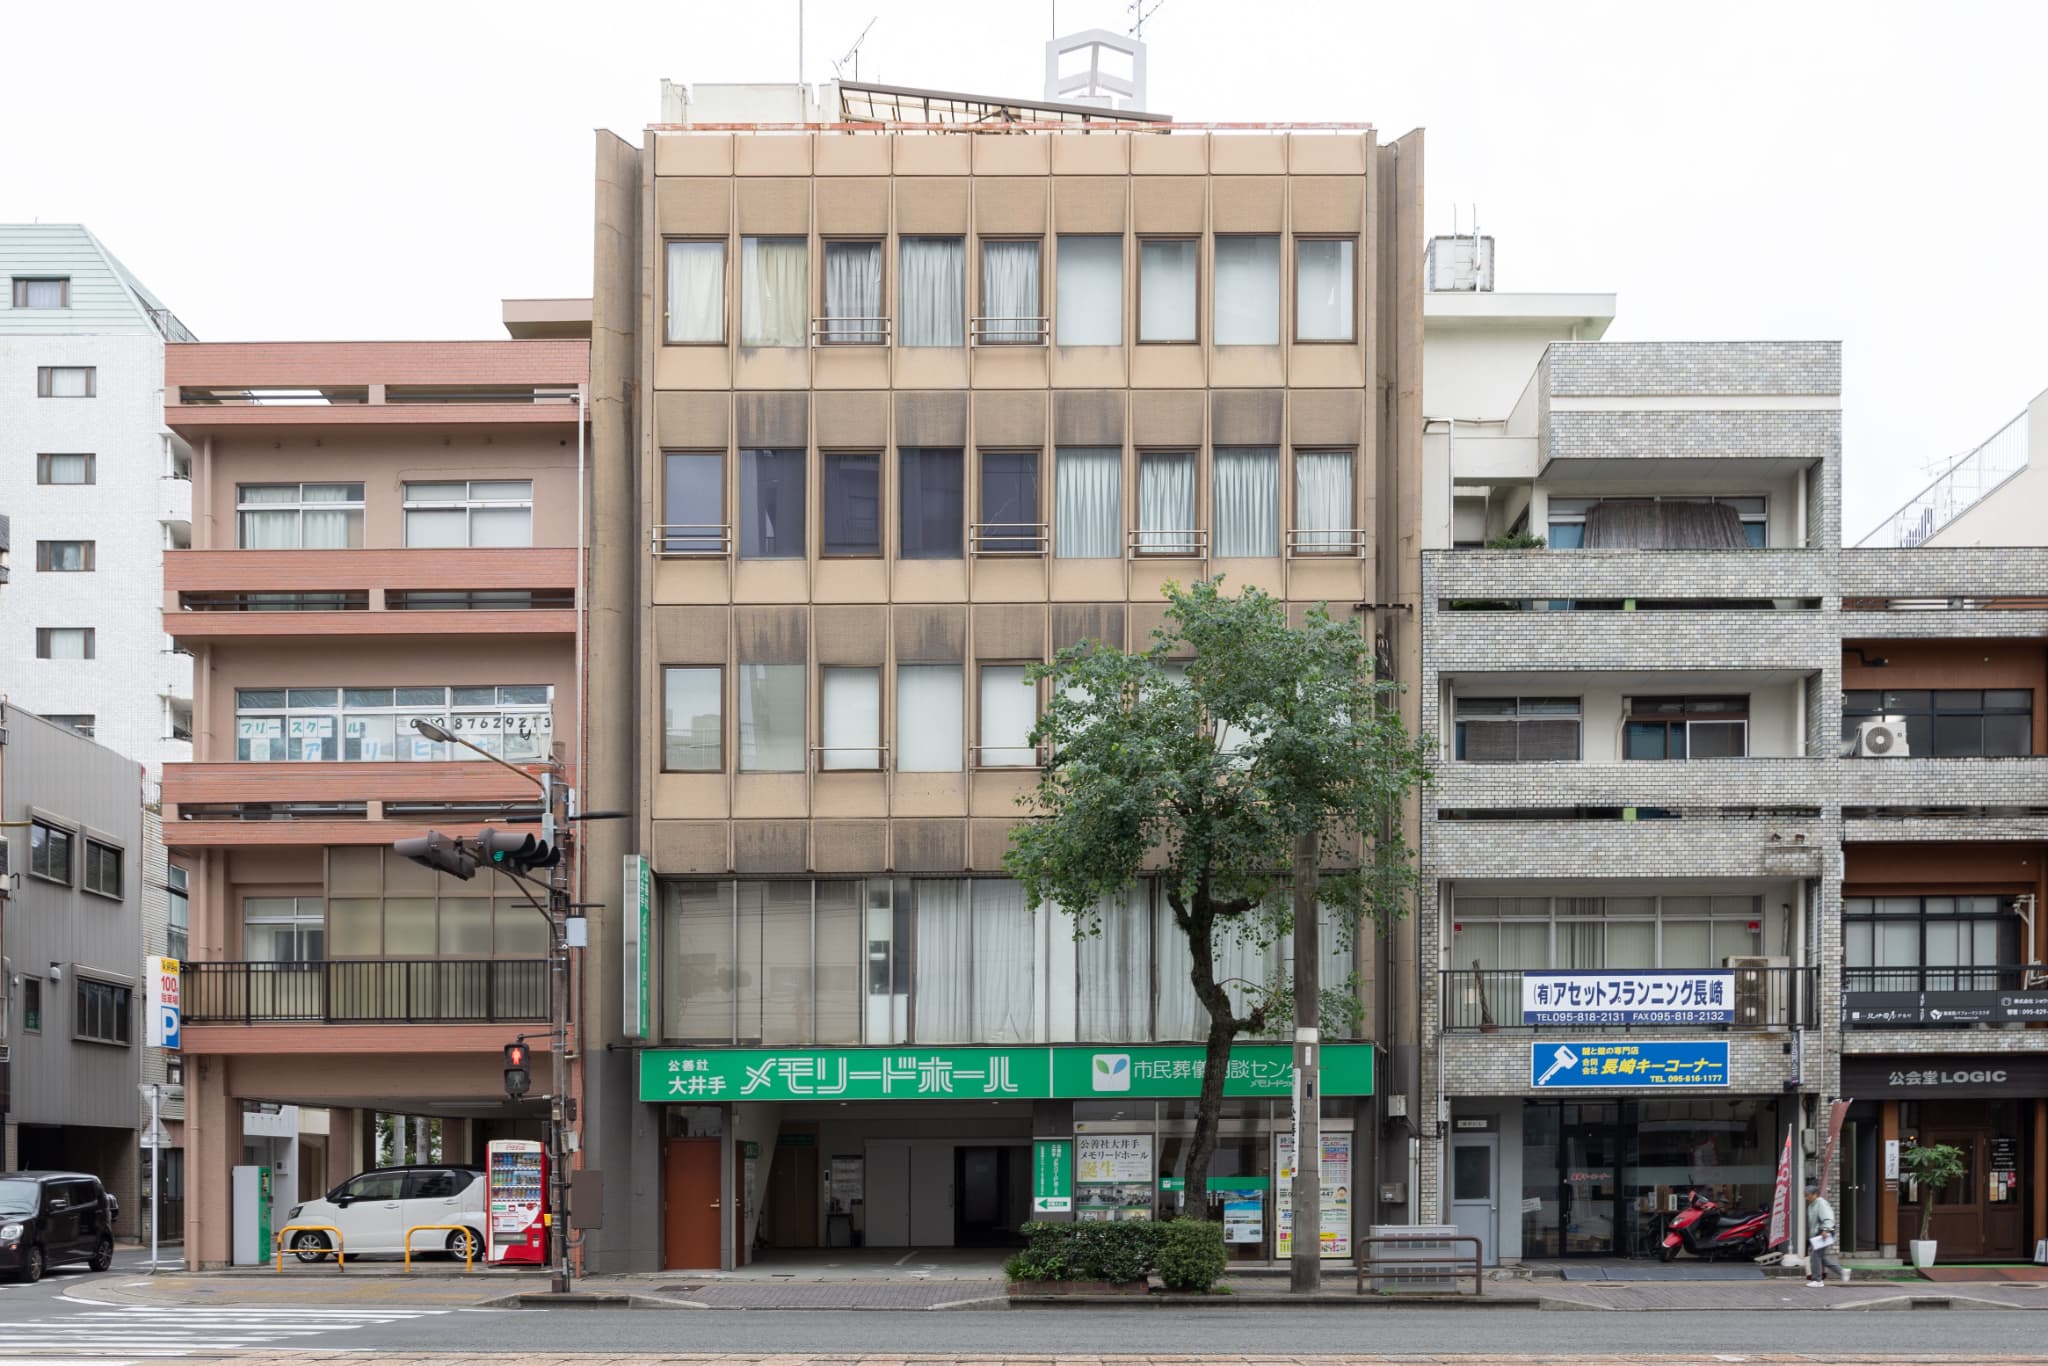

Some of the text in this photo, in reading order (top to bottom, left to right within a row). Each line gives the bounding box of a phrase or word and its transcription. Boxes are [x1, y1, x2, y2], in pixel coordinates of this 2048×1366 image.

[1534, 979, 1723, 1006] (有)アセットプランニング長崎
[668, 1059, 709, 1072] 公善社
[1601, 1058, 1722, 1074] 長崎キーコーナー
[740, 1056, 1019, 1095] メモリードホール
[1889, 1070, 2007, 1086] 公会堂 LOGIC
[668, 1075, 727, 1095] 大井手
[1080, 1139, 1140, 1149] 公善社大井手
[1081, 1151, 1149, 1160] メモリードホール
